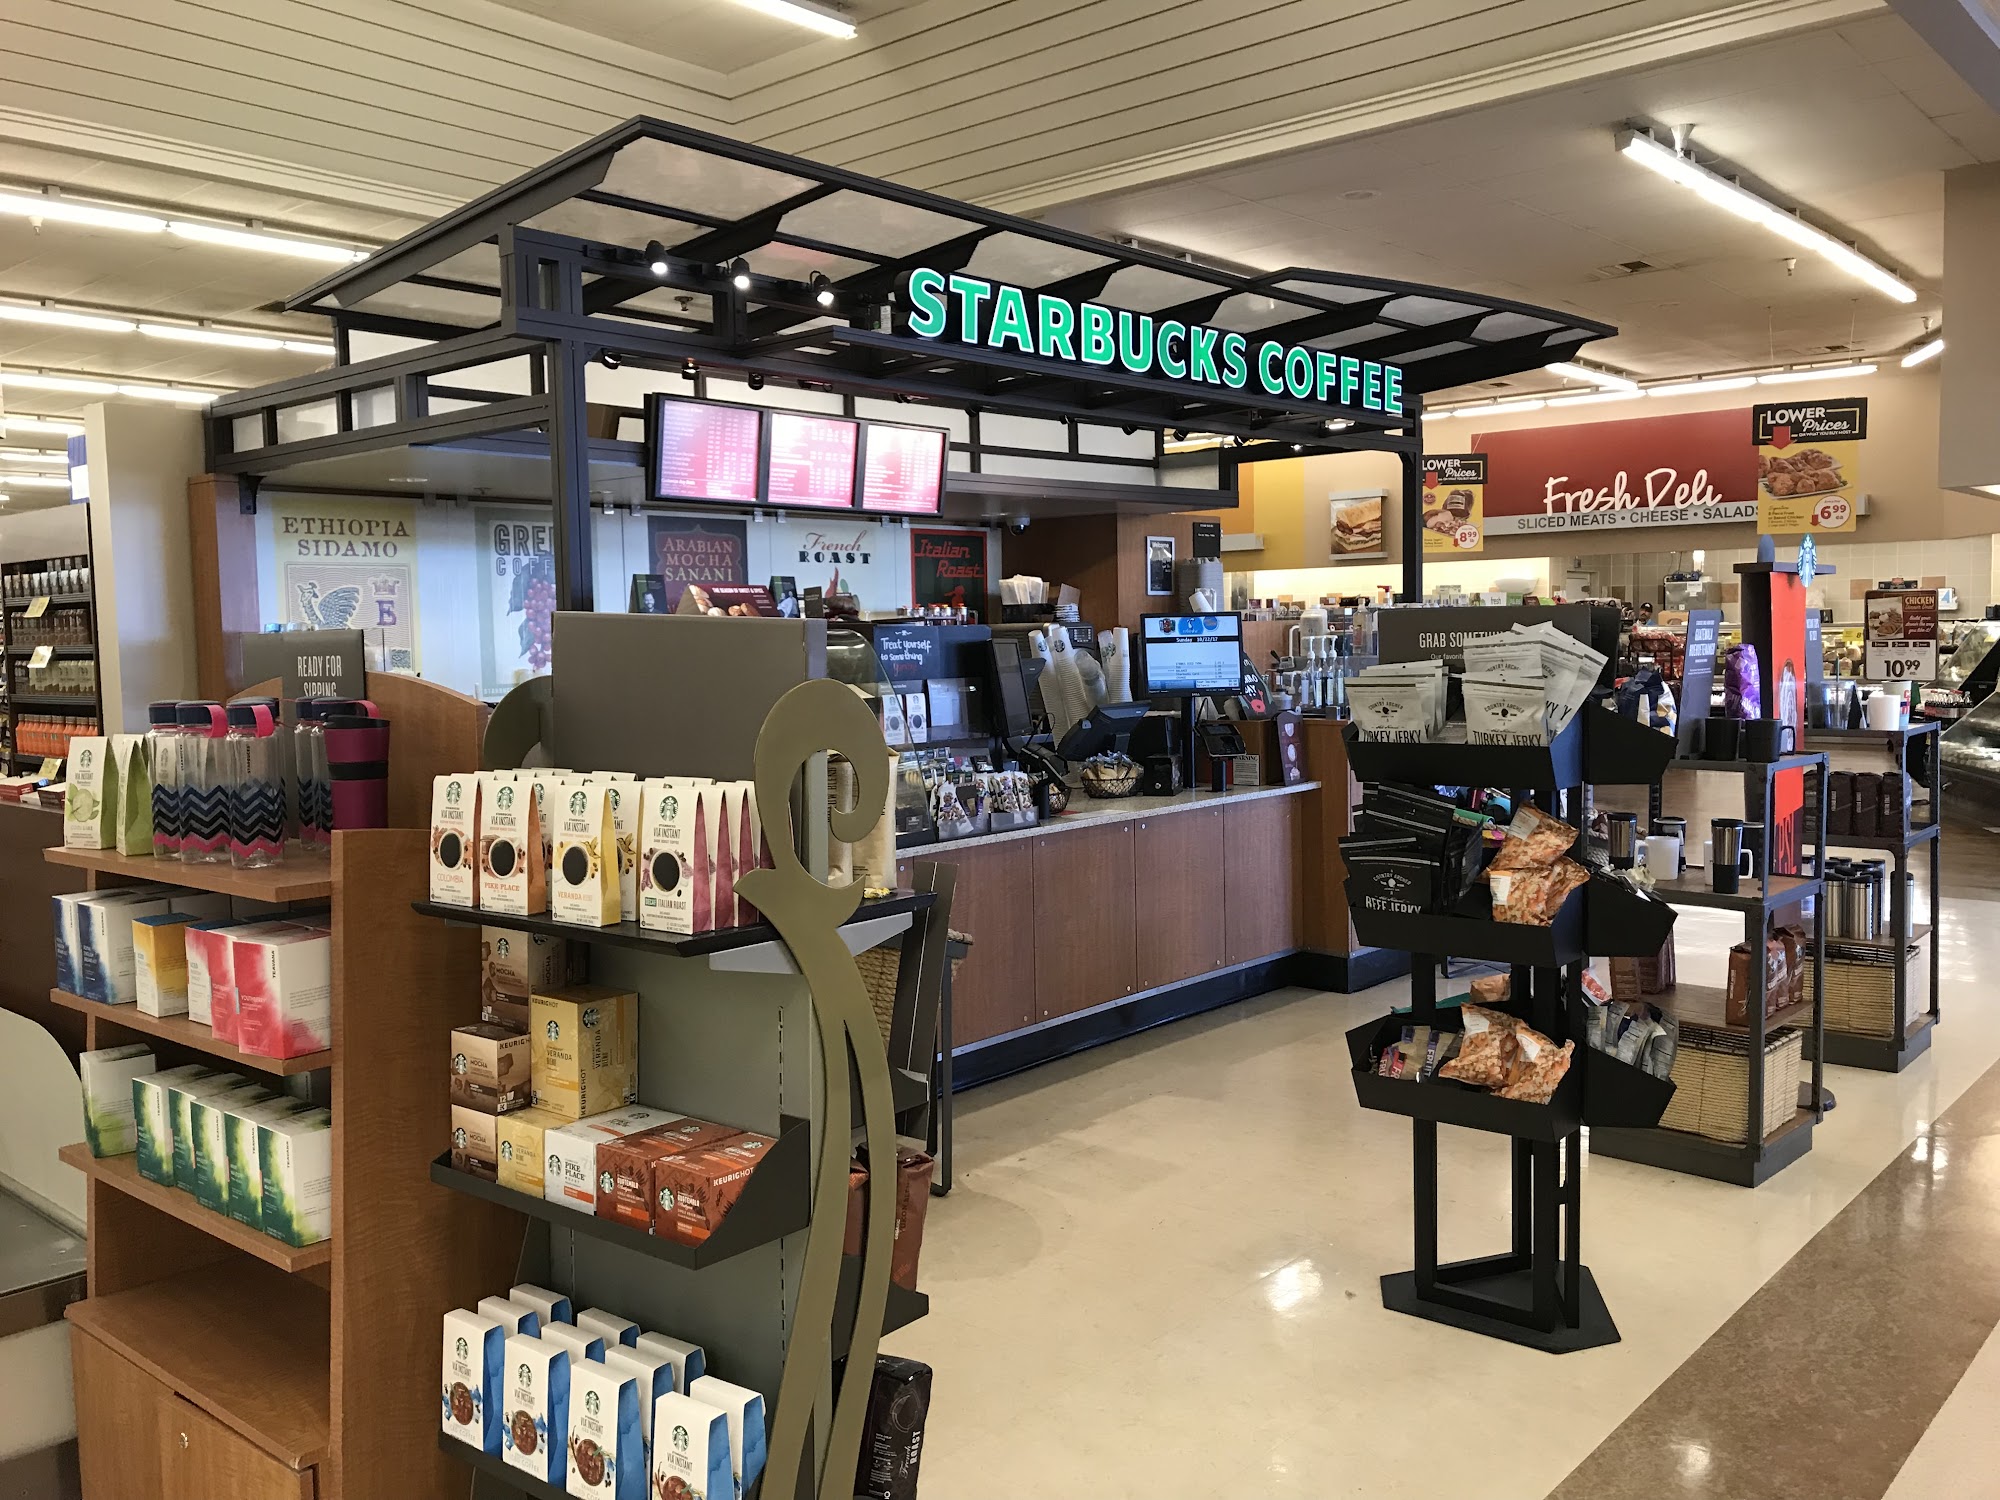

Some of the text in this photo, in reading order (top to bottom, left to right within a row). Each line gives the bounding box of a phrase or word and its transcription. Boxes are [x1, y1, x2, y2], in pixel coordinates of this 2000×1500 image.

[908, 267, 1403, 413] STARBUCKS COFFEE
[1767, 407, 1825, 425] LOWER
[1802, 419, 1850, 432] Prices
[1422, 459, 1460, 471] LOWER
[1445, 467, 1477, 477] Prices
[1543, 468, 1723, 517] Fresh Deli
[282, 516, 410, 537] ETHIOPIA
[1518, 515, 1566, 530] SLICED
[1570, 513, 1616, 527] MEATS
[1629, 509, 1689, 523] CHEESE
[663, 538, 732, 553] ARABIAN
[803, 530, 867, 551] French
[298, 539, 398, 558] SIDAMO
[914, 539, 970, 558] Italian
[666, 553, 732, 566] MOCHA
[798, 551, 871, 564] ROAST
[665, 567, 732, 581] SANANI
[936, 560, 985, 578] Roast
[1905, 596, 1935, 606] CHICKEN
[880, 637, 932, 654] Treat yourself
[1419, 632, 1446, 648] GRAB
[881, 651, 922, 665] to something
[298, 656, 342, 677] READY FOR
[1484, 703, 1505, 713] COUNTRY
[1362, 728, 1421, 743] TURKEY JERKY
[1473, 731, 1542, 746] TURKEY JERKY
[448, 810, 464, 820] INSTANT
[491, 815, 516, 827] VIA INSTANT
[563, 821, 590, 833] VIA INSTANT
[653, 827, 681, 839] VIA INSTANT
[1778, 811, 1797, 875] PSL
[437, 873, 464, 883] COLOMBIA
[500, 883, 520, 891] PLACE
[558, 891, 582, 900] VERANDA
[657, 897, 672, 909] ITALIAN
[673, 899, 687, 910] ROAST
[1365, 895, 1422, 914] BEEF JERKY
[496, 968, 516, 977] MOCHA
[547, 1049, 573, 1061] VERANDA
[470, 1060, 488, 1069] MOCHA
[469, 1133, 487, 1143] MOCHA
[565, 1161, 581, 1173] PIKE
[565, 1169, 585, 1181] PLACE
[457, 1364, 472, 1378] INSTANT
[519, 1391, 535, 1406] INSTANT
[587, 1418, 604, 1435] INSTANT
[910, 1431, 921, 1465] ROAST
[674, 1455, 693, 1472] INSTANT
[899, 1445, 911, 1479] French
